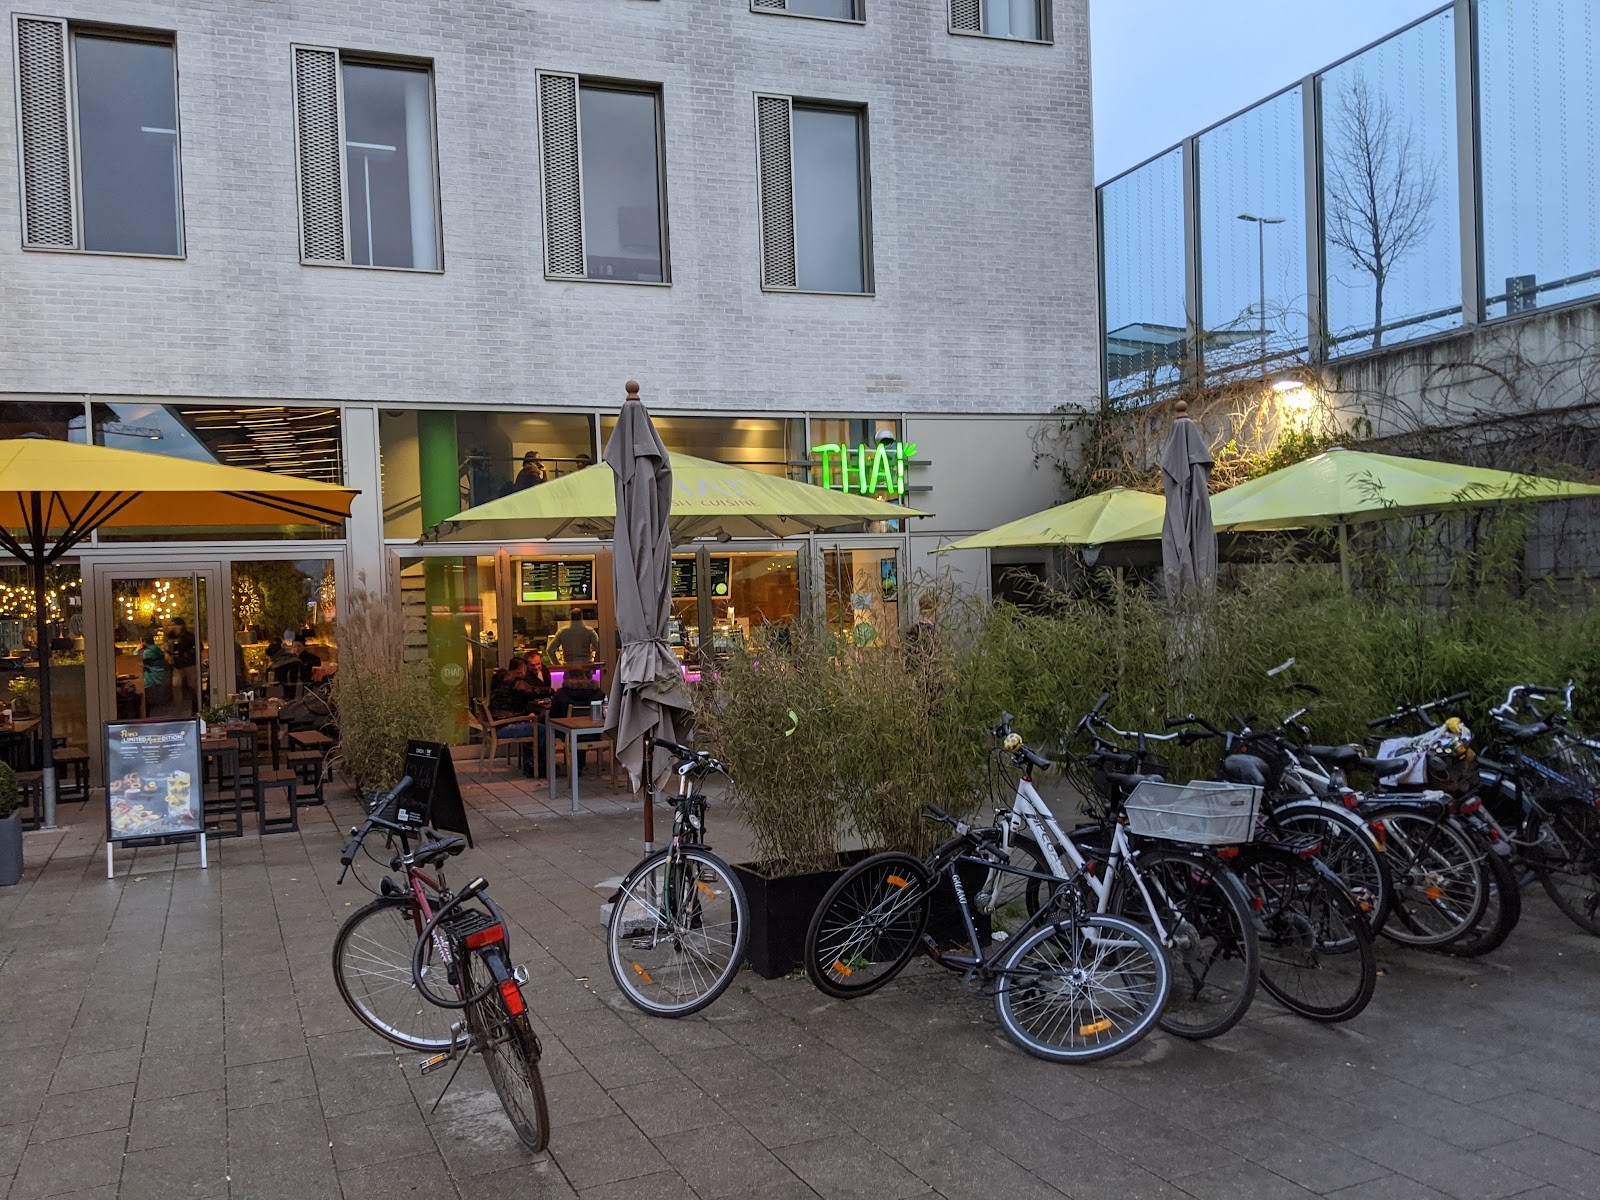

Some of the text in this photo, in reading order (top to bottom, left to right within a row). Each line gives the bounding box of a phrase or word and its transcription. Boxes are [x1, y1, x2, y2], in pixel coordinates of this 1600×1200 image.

[811, 442, 905, 495] THAI
[671, 499, 761, 507] SH CUISINE
